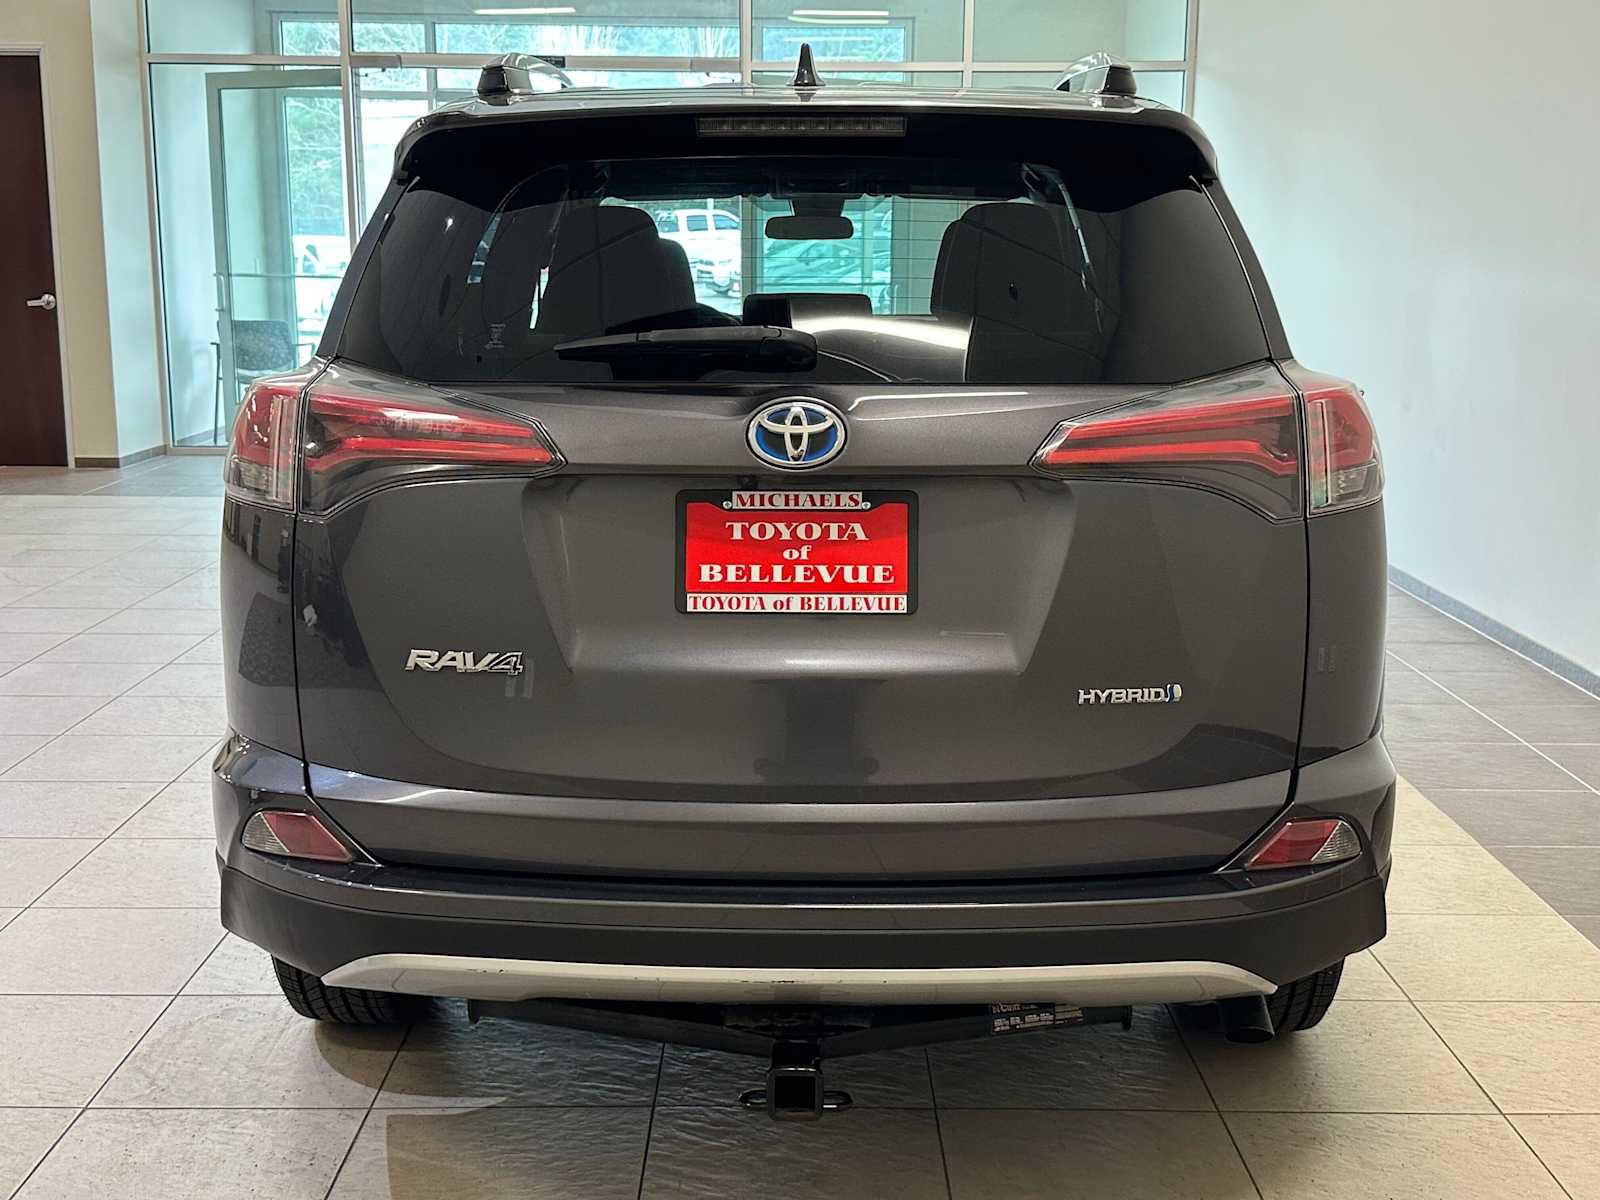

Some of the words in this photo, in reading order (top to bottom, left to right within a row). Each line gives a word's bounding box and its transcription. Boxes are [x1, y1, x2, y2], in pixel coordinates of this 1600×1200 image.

[735, 493, 862, 507] MICHAELS
[726, 522, 868, 540] TOYOTA
[783, 545, 811, 560] of
[699, 564, 895, 583] BELLEVUE
[689, 596, 766, 610] TOYOTA
[773, 595, 793, 610] of
[800, 597, 905, 611] BELLEVUE
[405, 649, 524, 675] RAV4
[1078, 687, 1168, 704] HYBRID
